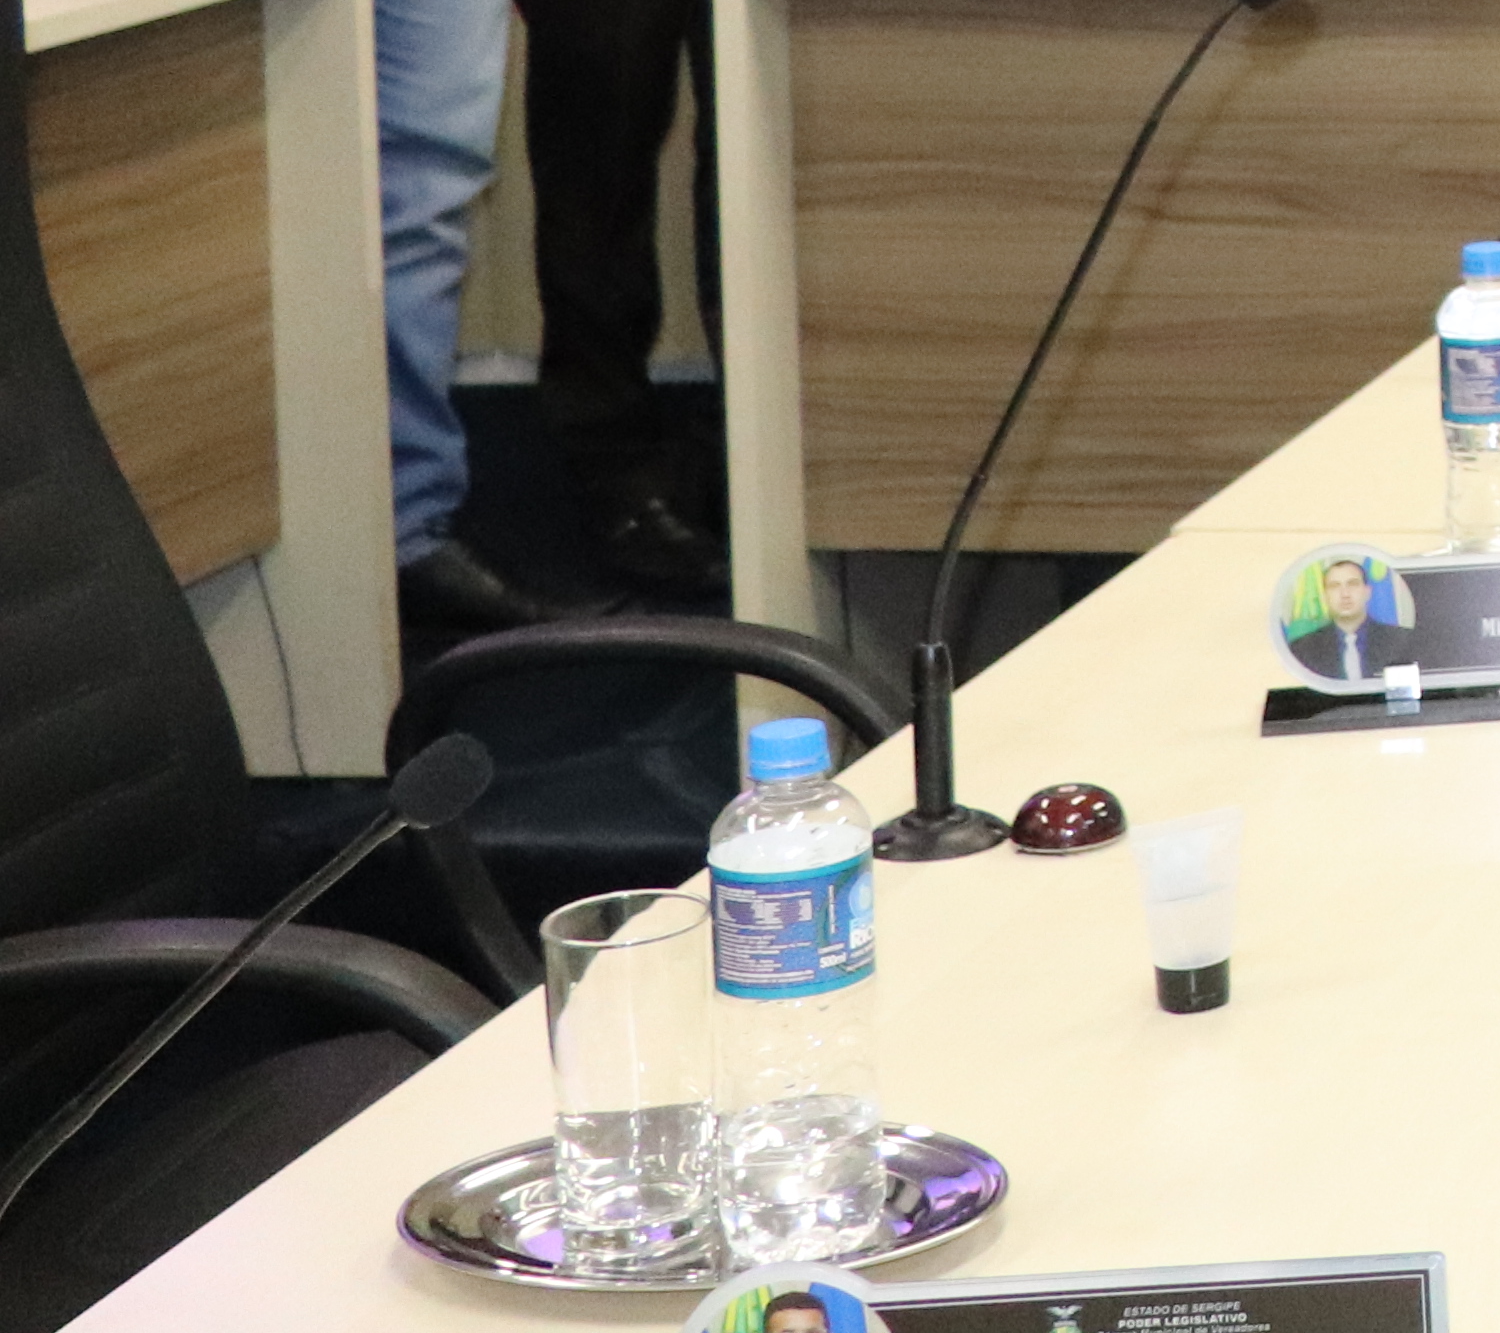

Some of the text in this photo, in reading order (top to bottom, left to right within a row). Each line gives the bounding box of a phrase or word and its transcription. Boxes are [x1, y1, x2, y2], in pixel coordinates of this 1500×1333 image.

[1123, 1300, 1242, 1318] ESTADO DE SERGIPE
[1117, 1312, 1248, 1329] PODER LEGISLATIVO
